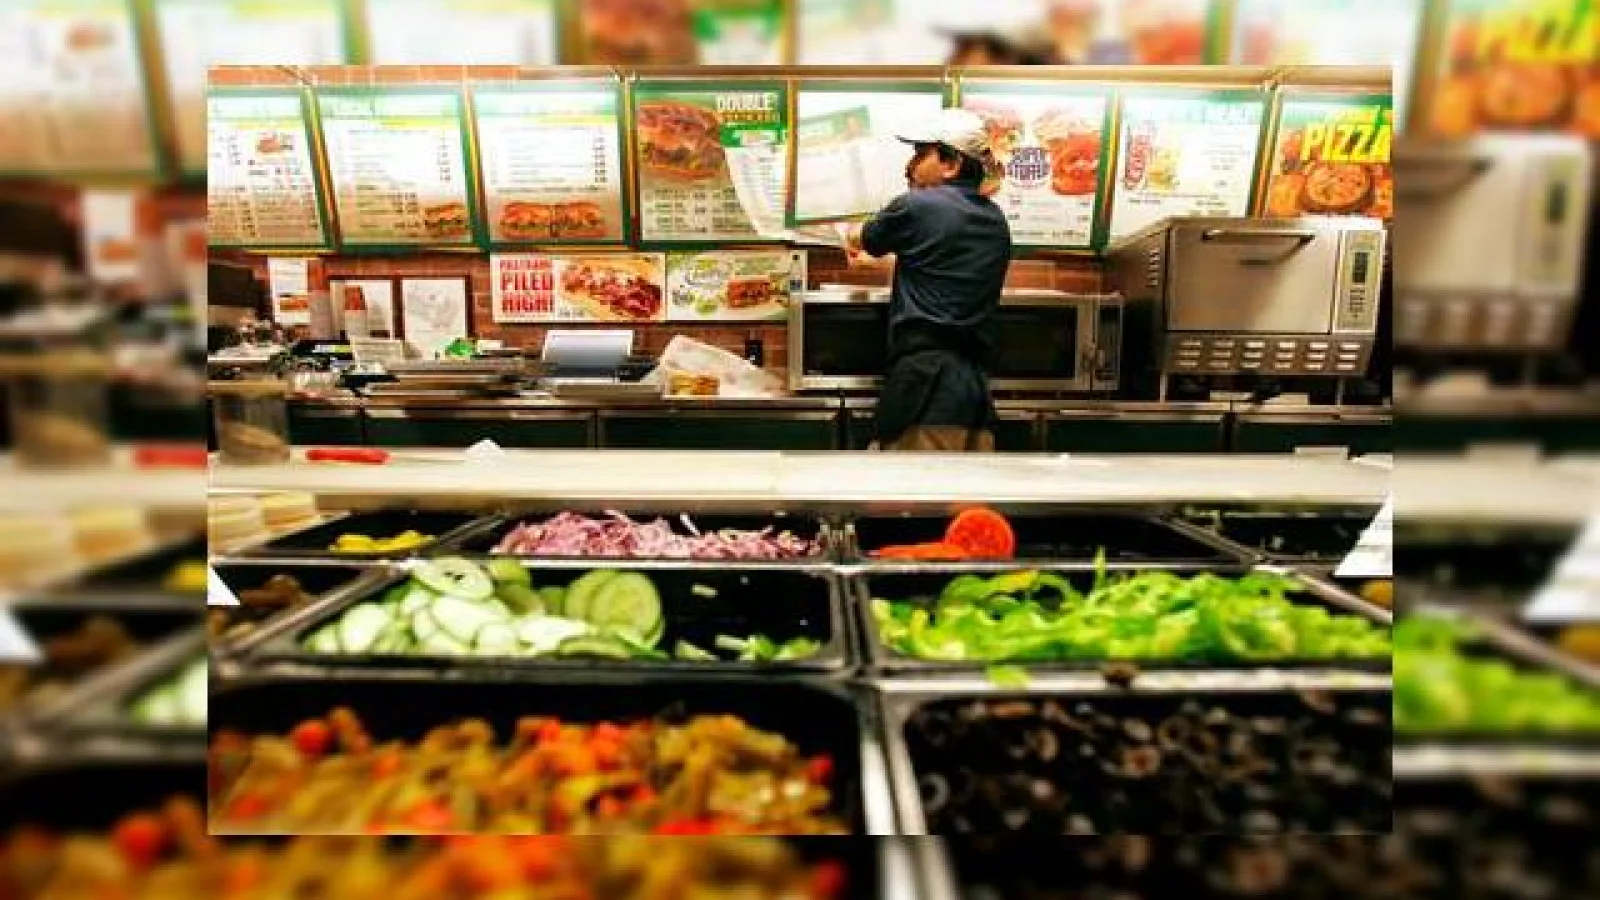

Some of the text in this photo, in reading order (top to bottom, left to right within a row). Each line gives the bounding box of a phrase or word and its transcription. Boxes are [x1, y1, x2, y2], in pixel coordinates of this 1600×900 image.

[714, 92, 774, 111] DOUBLE
[1302, 124, 1392, 162] PIZZA
[500, 272, 554, 291] PILED
